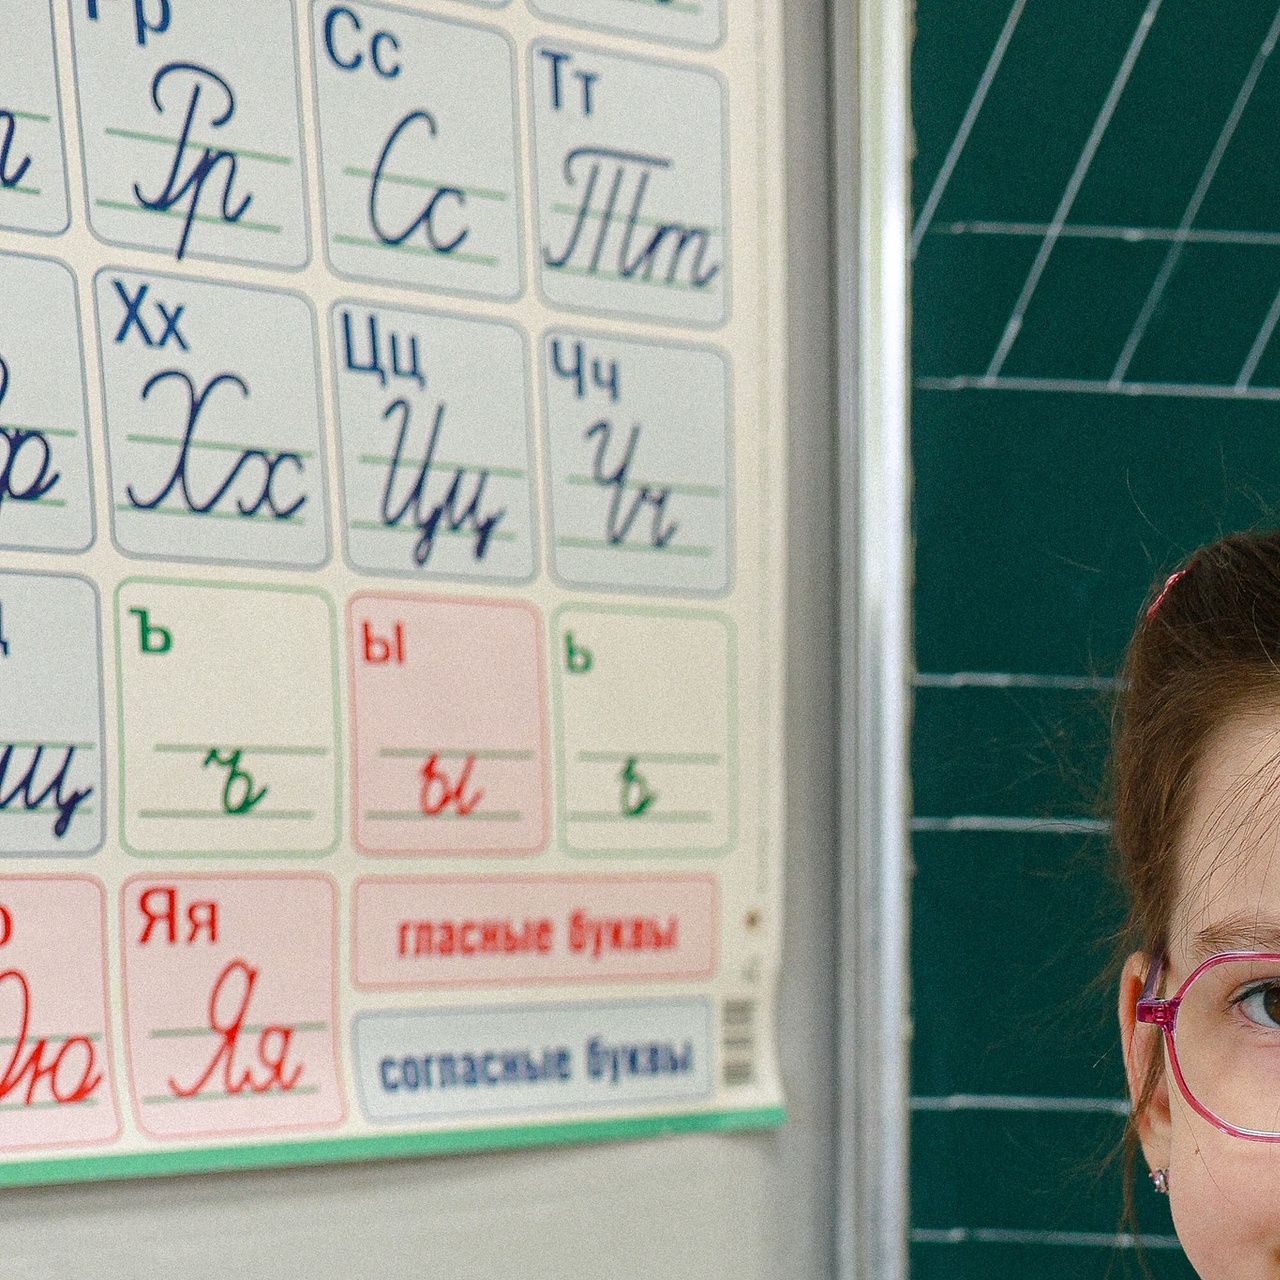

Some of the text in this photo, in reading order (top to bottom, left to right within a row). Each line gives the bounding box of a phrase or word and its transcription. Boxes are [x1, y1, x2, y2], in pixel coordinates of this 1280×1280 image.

[323, 6, 401, 79] Сс
[540, 49, 602, 117] Тт
[134, 62, 252, 261] Рр
[369, 110, 468, 256] Сс
[543, 147, 719, 290] Тт
[112, 280, 190, 352] Хх
[342, 311, 426, 390] Цц
[550, 339, 620, 402] Чч
[126, 369, 307, 522] Хх
[382, 398, 506, 568] Цц
[585, 420, 678, 552] Чч
[138, 886, 219, 946] Яя
[398, 909, 678, 956] гласные буквы
[169, 958, 303, 1098] Яя
[379, 1037, 694, 1093] согласные буквы
